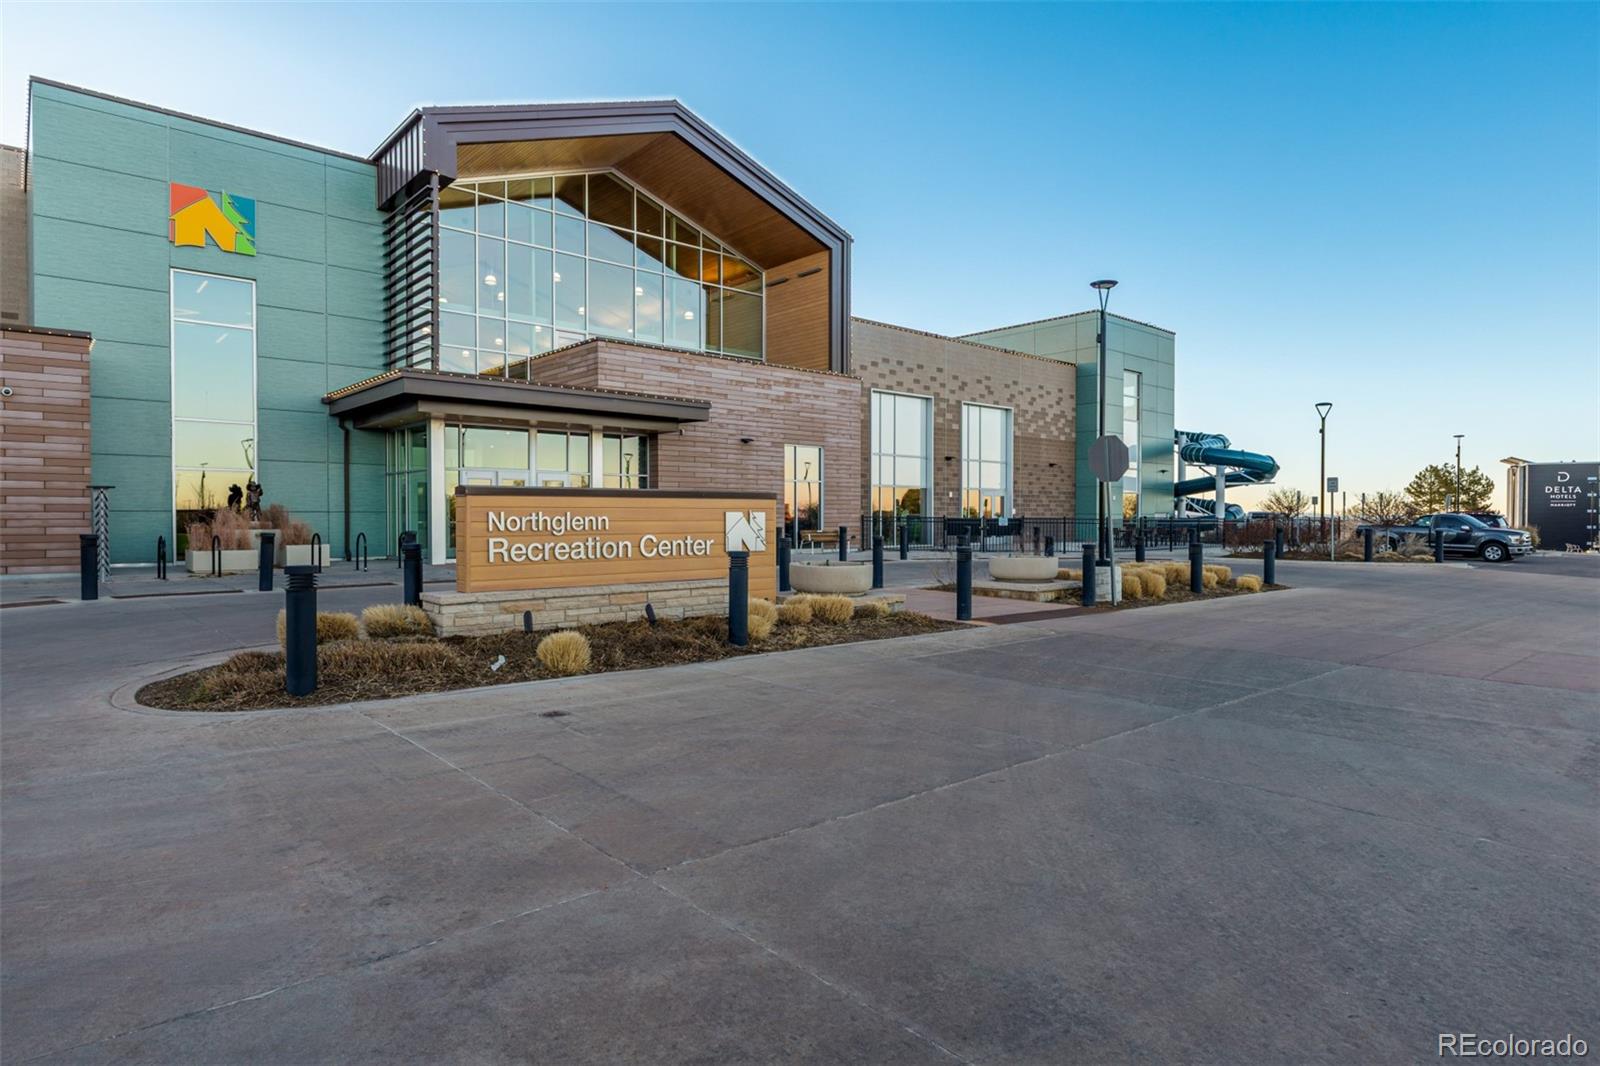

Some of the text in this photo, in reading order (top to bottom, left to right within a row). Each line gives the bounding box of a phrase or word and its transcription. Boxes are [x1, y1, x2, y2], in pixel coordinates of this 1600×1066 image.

[487, 511, 609, 536] Northglenn
[488, 534, 714, 563] Recreation Center
